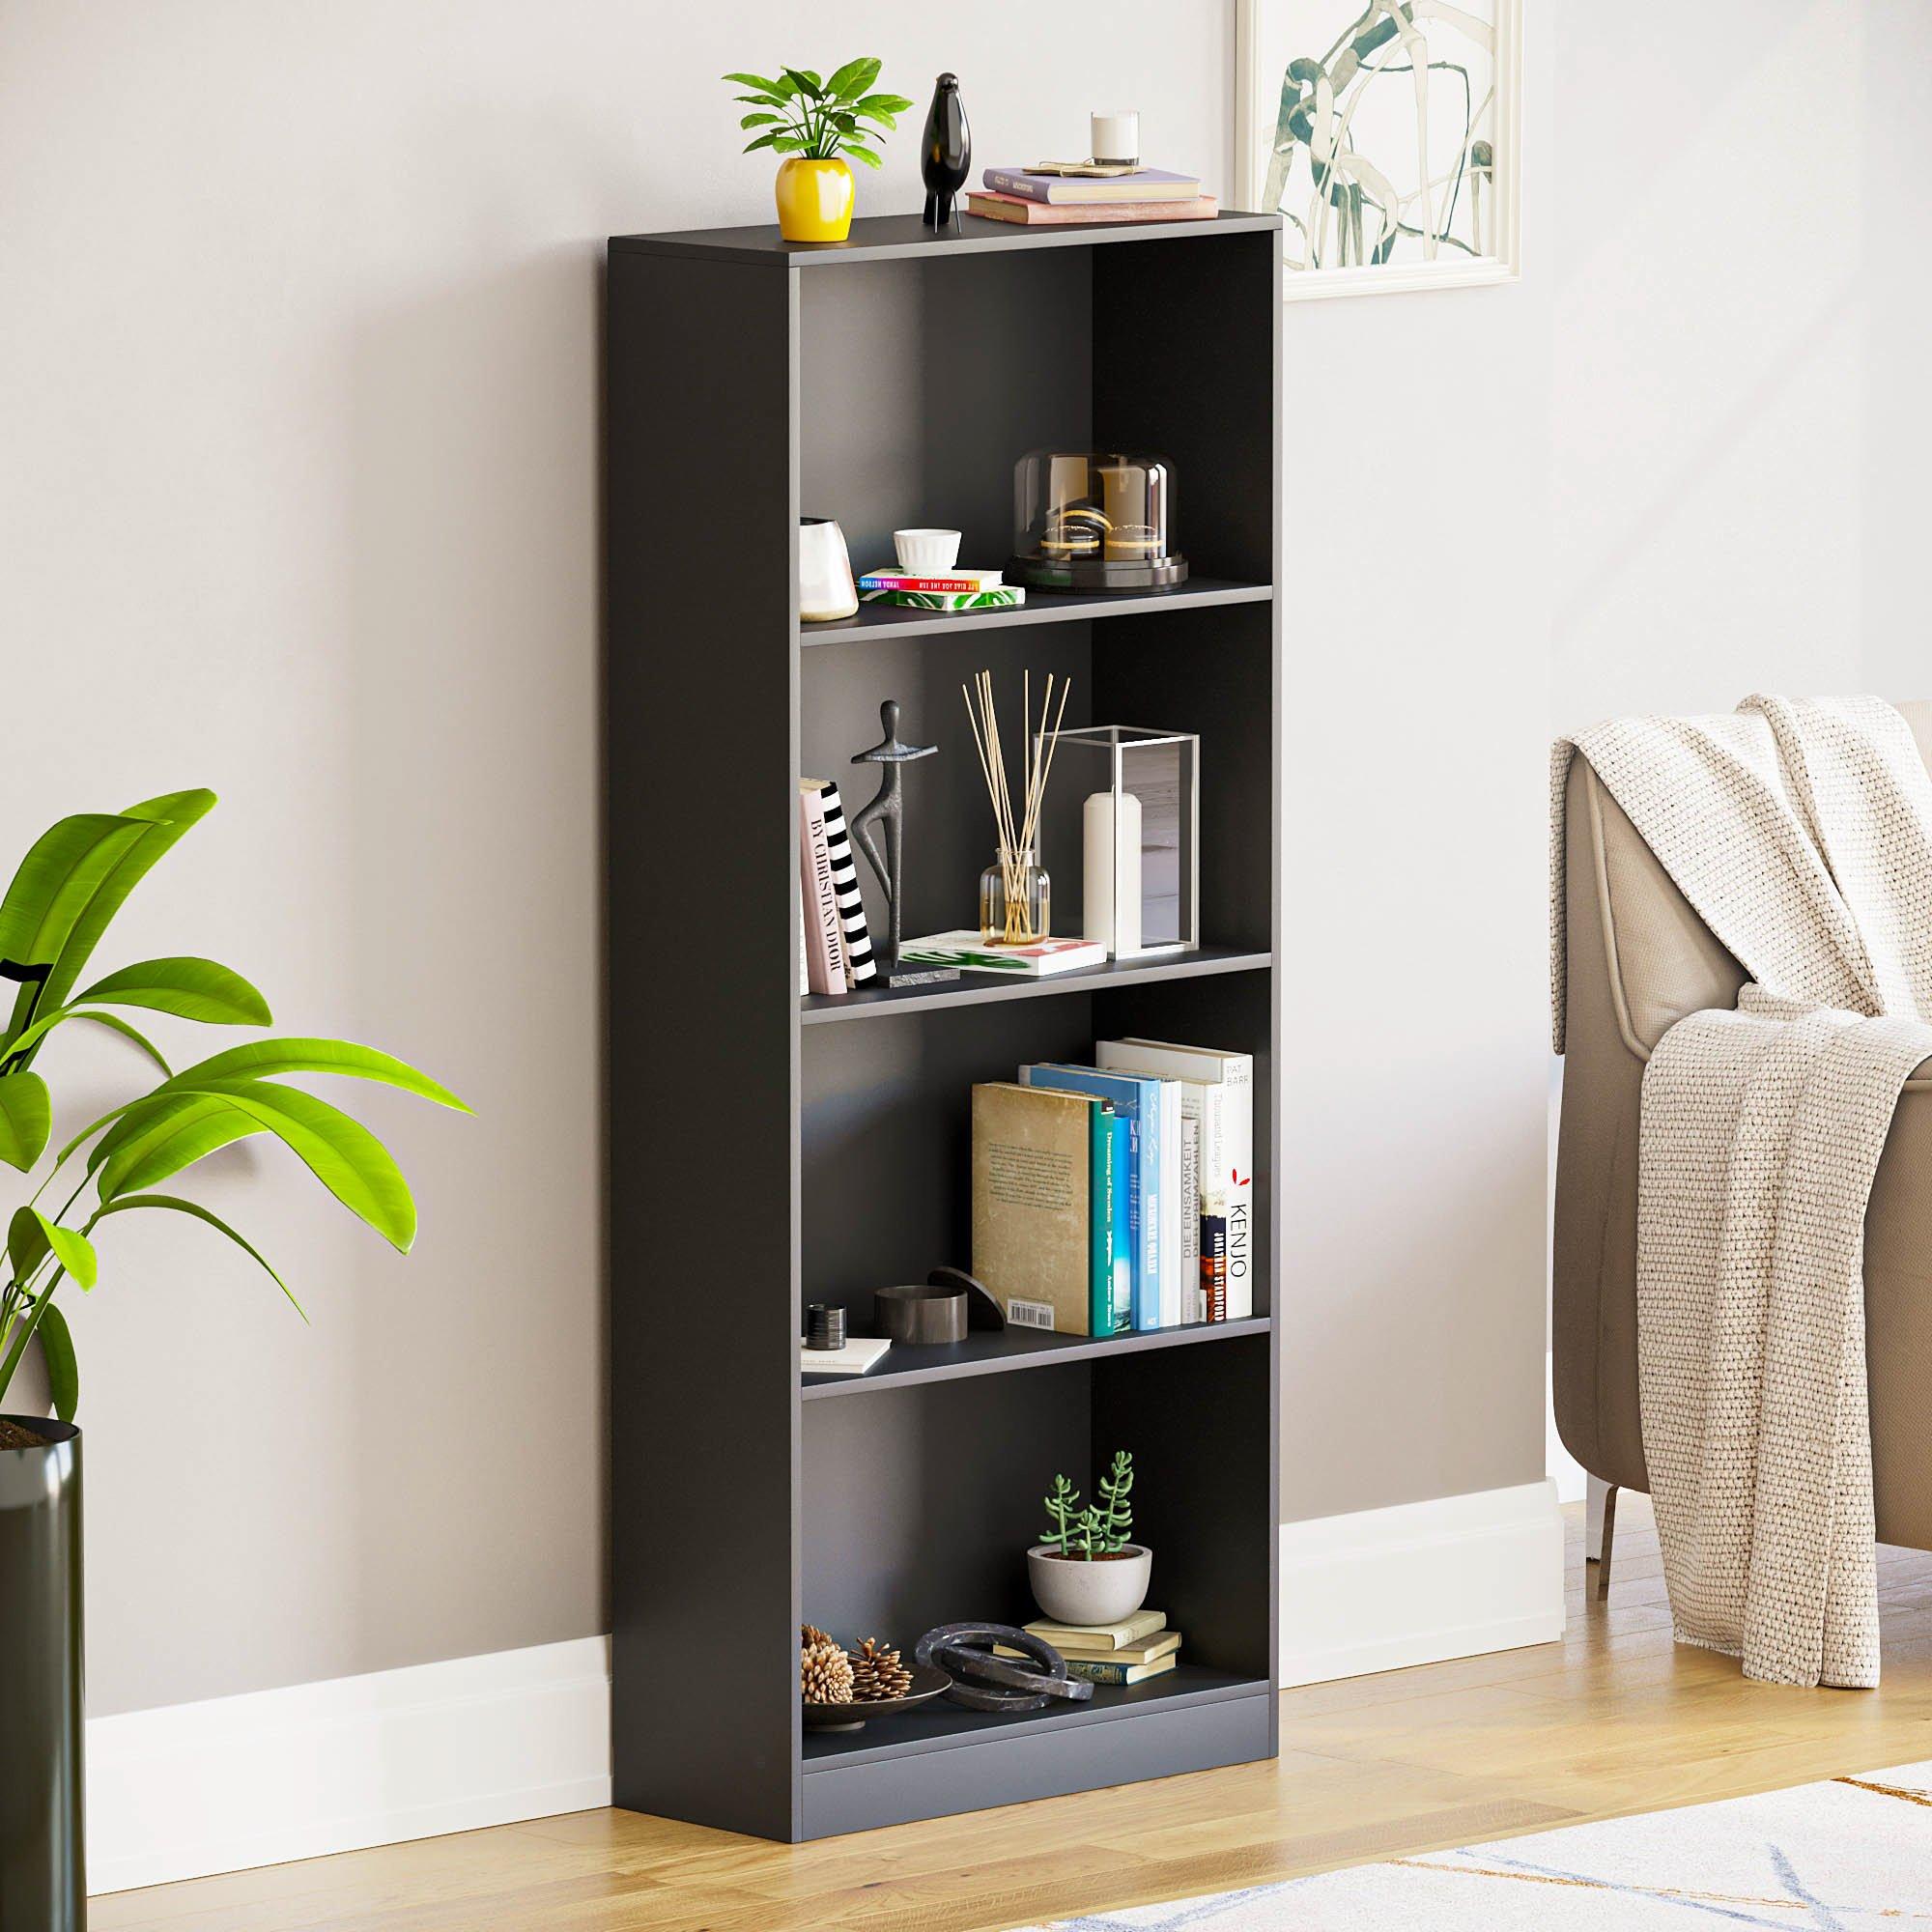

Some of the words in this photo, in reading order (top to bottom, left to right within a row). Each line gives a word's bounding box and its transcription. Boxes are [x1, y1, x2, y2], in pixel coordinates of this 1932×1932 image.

[810, 819, 823, 838] BY
[814, 843, 836, 927] CHRISTIAN
[826, 930, 841, 971] DIOR
[1213, 1232, 1224, 1274] JONATHAN
[1230, 1204, 1247, 1278] KENJO
